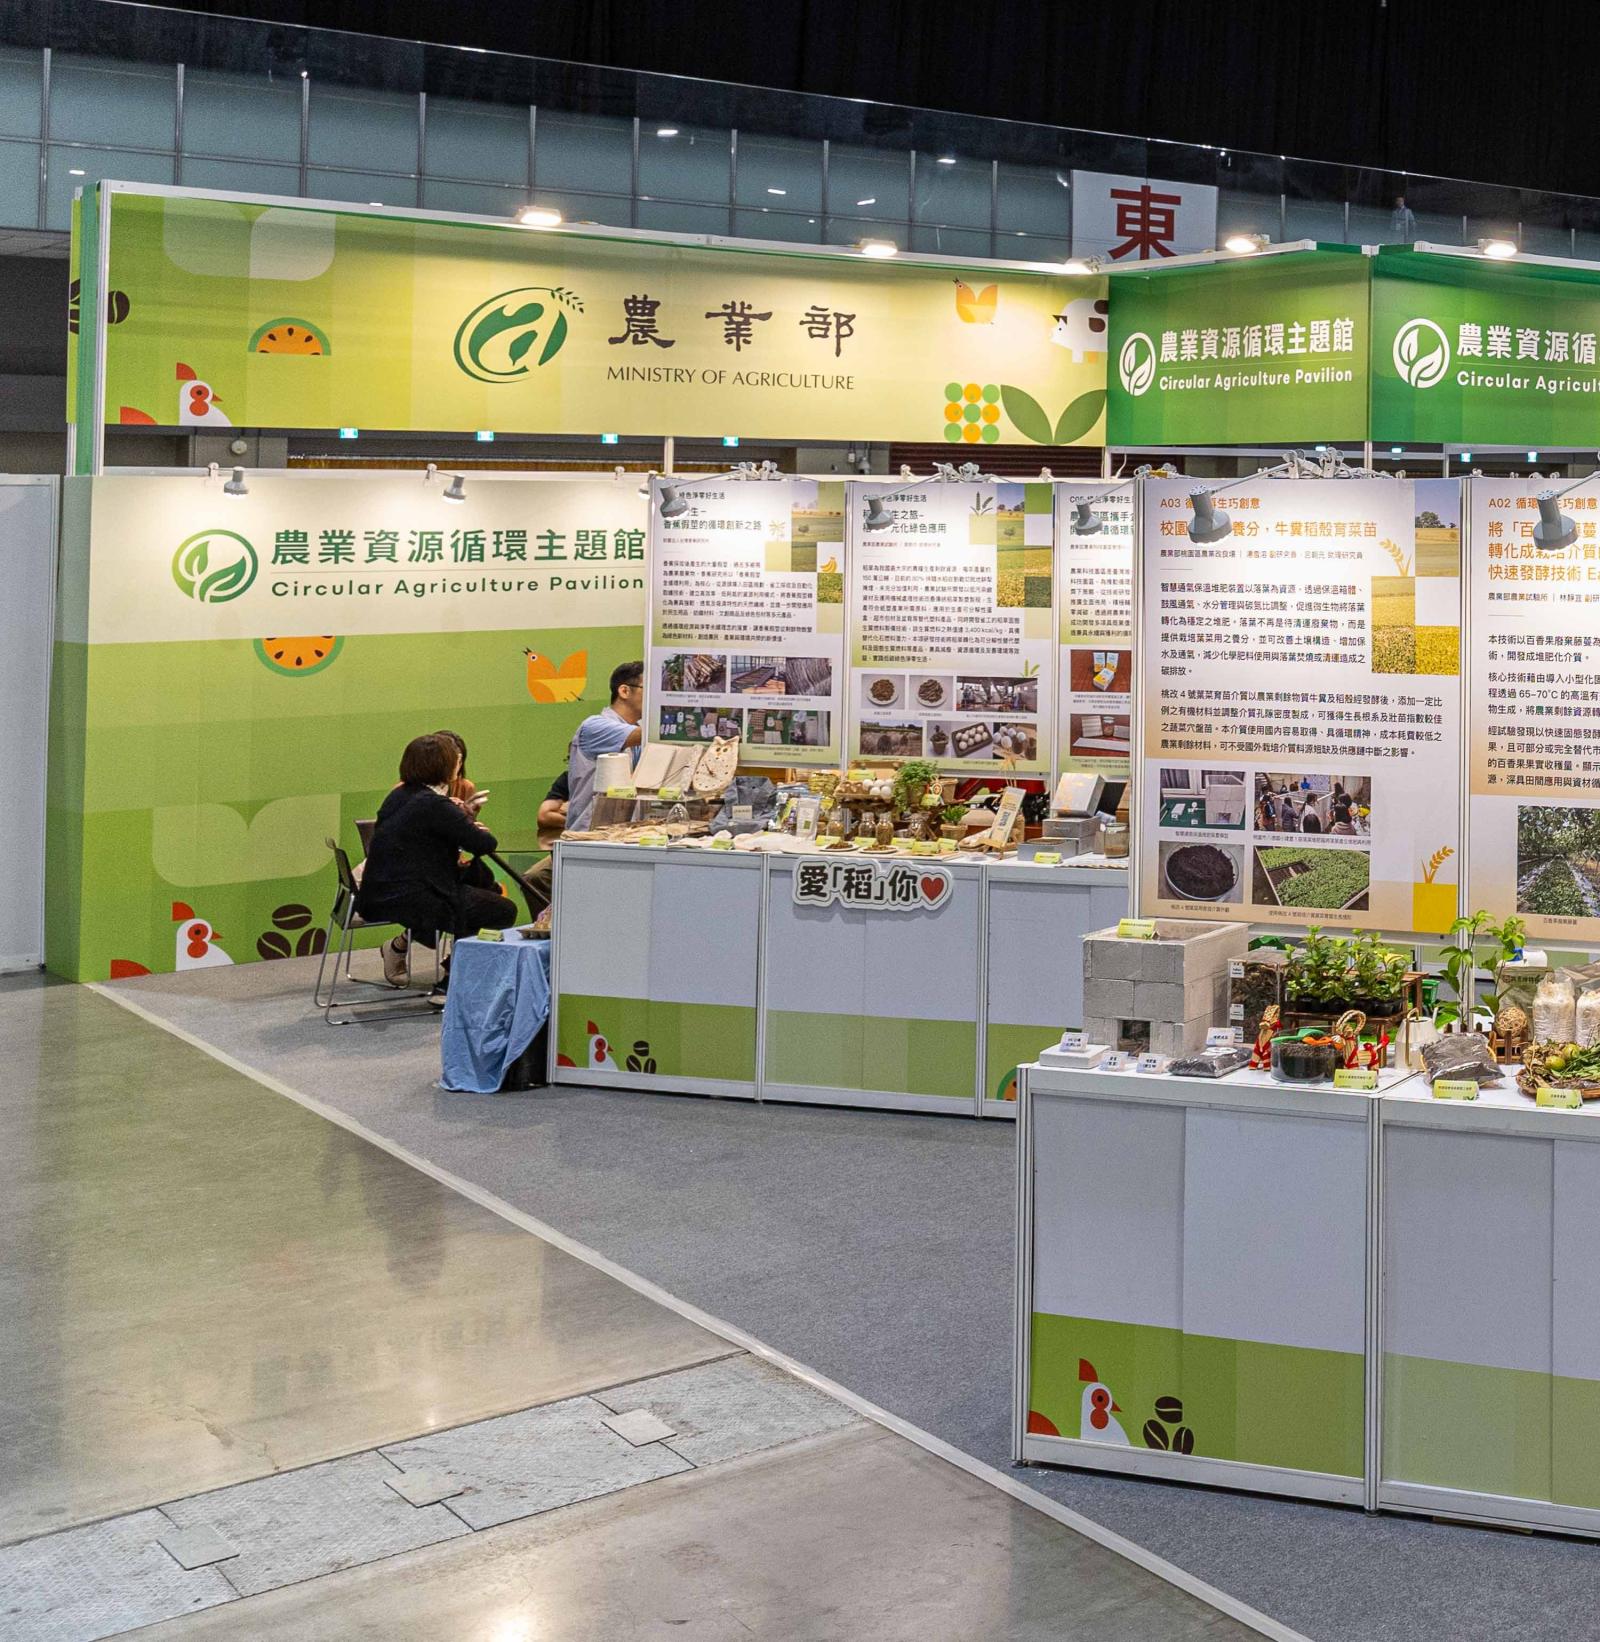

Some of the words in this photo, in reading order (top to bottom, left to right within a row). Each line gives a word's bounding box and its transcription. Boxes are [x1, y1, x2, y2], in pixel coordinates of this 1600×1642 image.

[1107, 185, 1182, 260] 東
[608, 295, 856, 357] 農業部
[1160, 318, 1354, 364] 農業資源循環主題館
[607, 366, 696, 385] MINISTRY
[702, 369, 727, 385] OF
[732, 371, 855, 390] AGRICULTURE
[1159, 375, 1210, 391] Circular
[1214, 371, 1290, 392] Agriculture
[1295, 367, 1352, 384] Pavilion
[1456, 371, 1529, 390] Circular
[1160, 498, 1181, 509] A03
[1488, 498, 1511, 508] A02
[1516, 497, 1598, 510] 循環巧創意
[1160, 520, 1378, 538] 校園養分，牛糞稻殼育菜苗
[270, 528, 646, 565] 農業資源循環主題館
[1488, 564, 1581, 581] 快速發酵技術
[271, 579, 383, 597] Circular
[394, 577, 539, 598] Agriculture
[550, 576, 644, 591] Pavilion
[799, 864, 918, 902] 愛「稻」你
